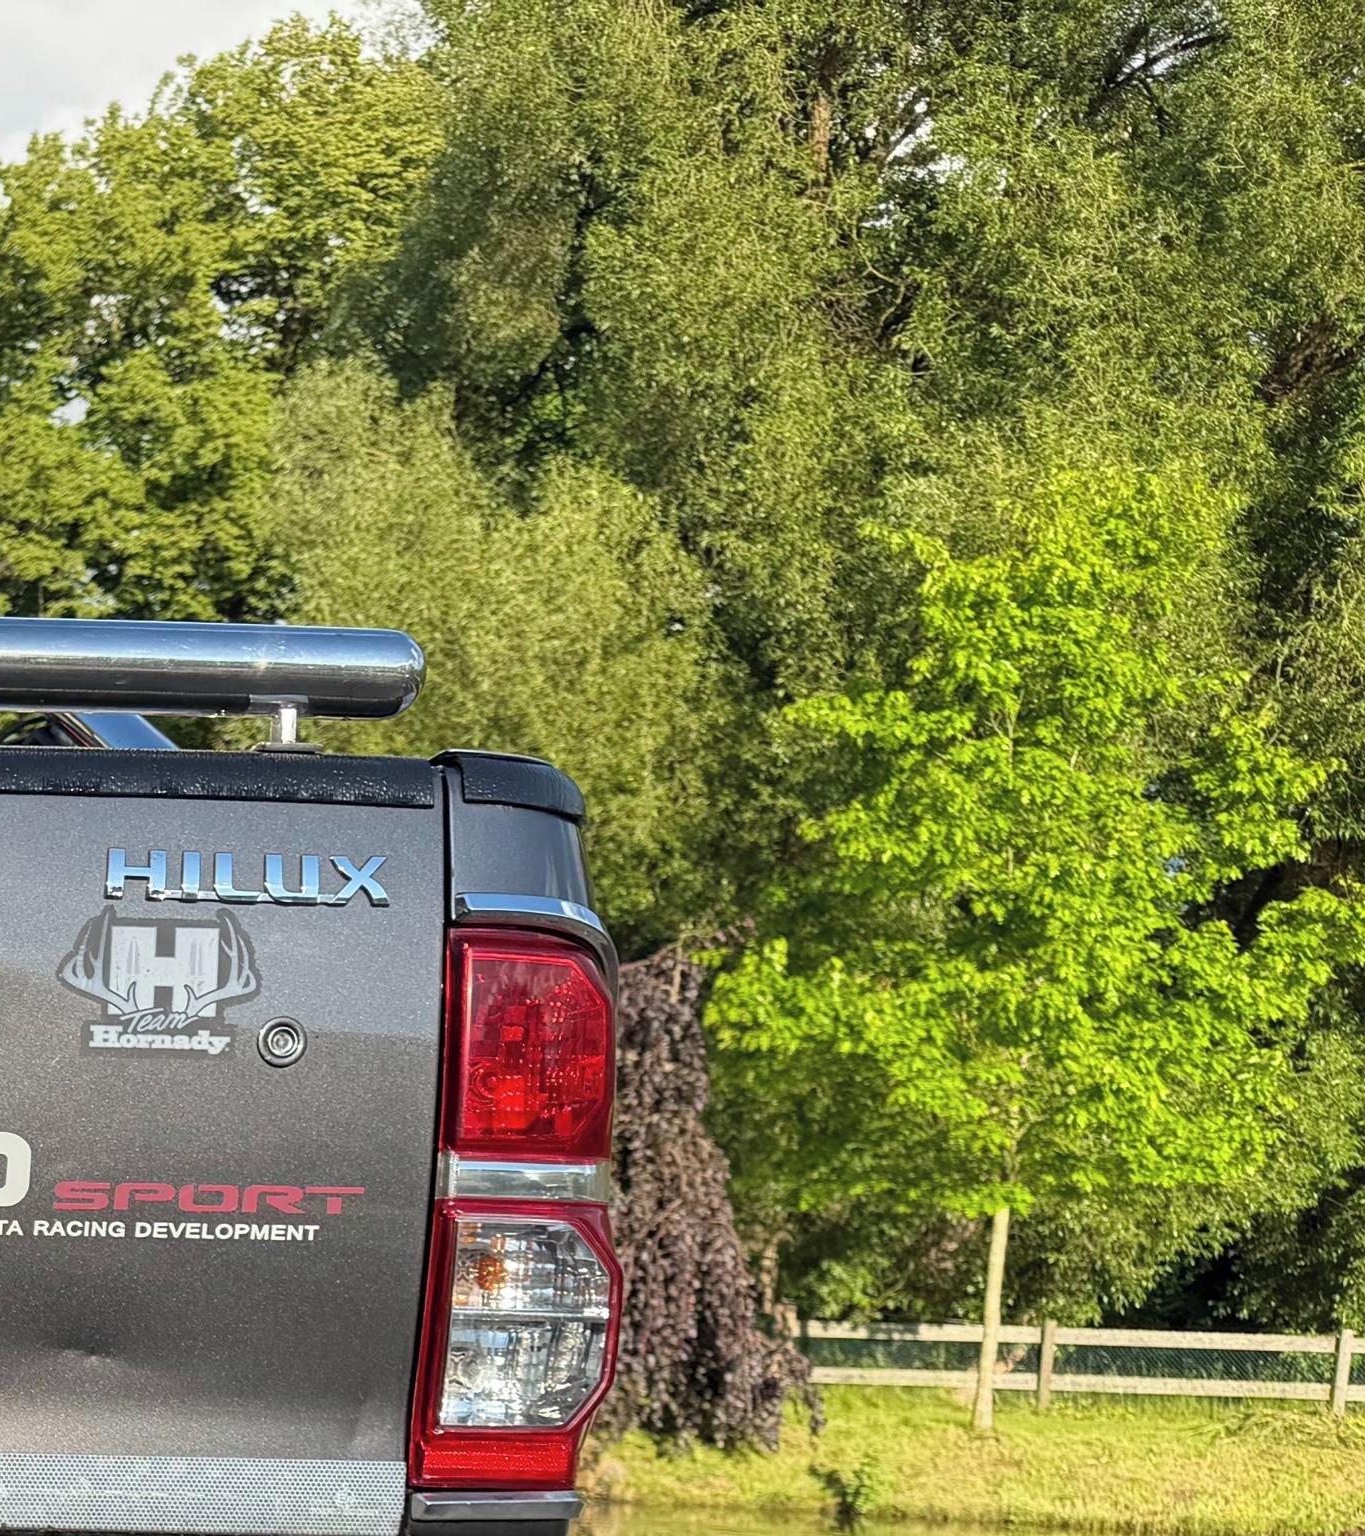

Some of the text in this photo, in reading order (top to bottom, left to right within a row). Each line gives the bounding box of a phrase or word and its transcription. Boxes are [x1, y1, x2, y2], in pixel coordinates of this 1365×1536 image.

[104, 847, 390, 907] HILUX
[120, 1007, 199, 1033] Team
[89, 1024, 231, 1055] Hornady
[53, 1181, 365, 1214] SPORT
[33, 1220, 126, 1238] RACING
[134, 1221, 320, 1242] DEVELOPMENT
